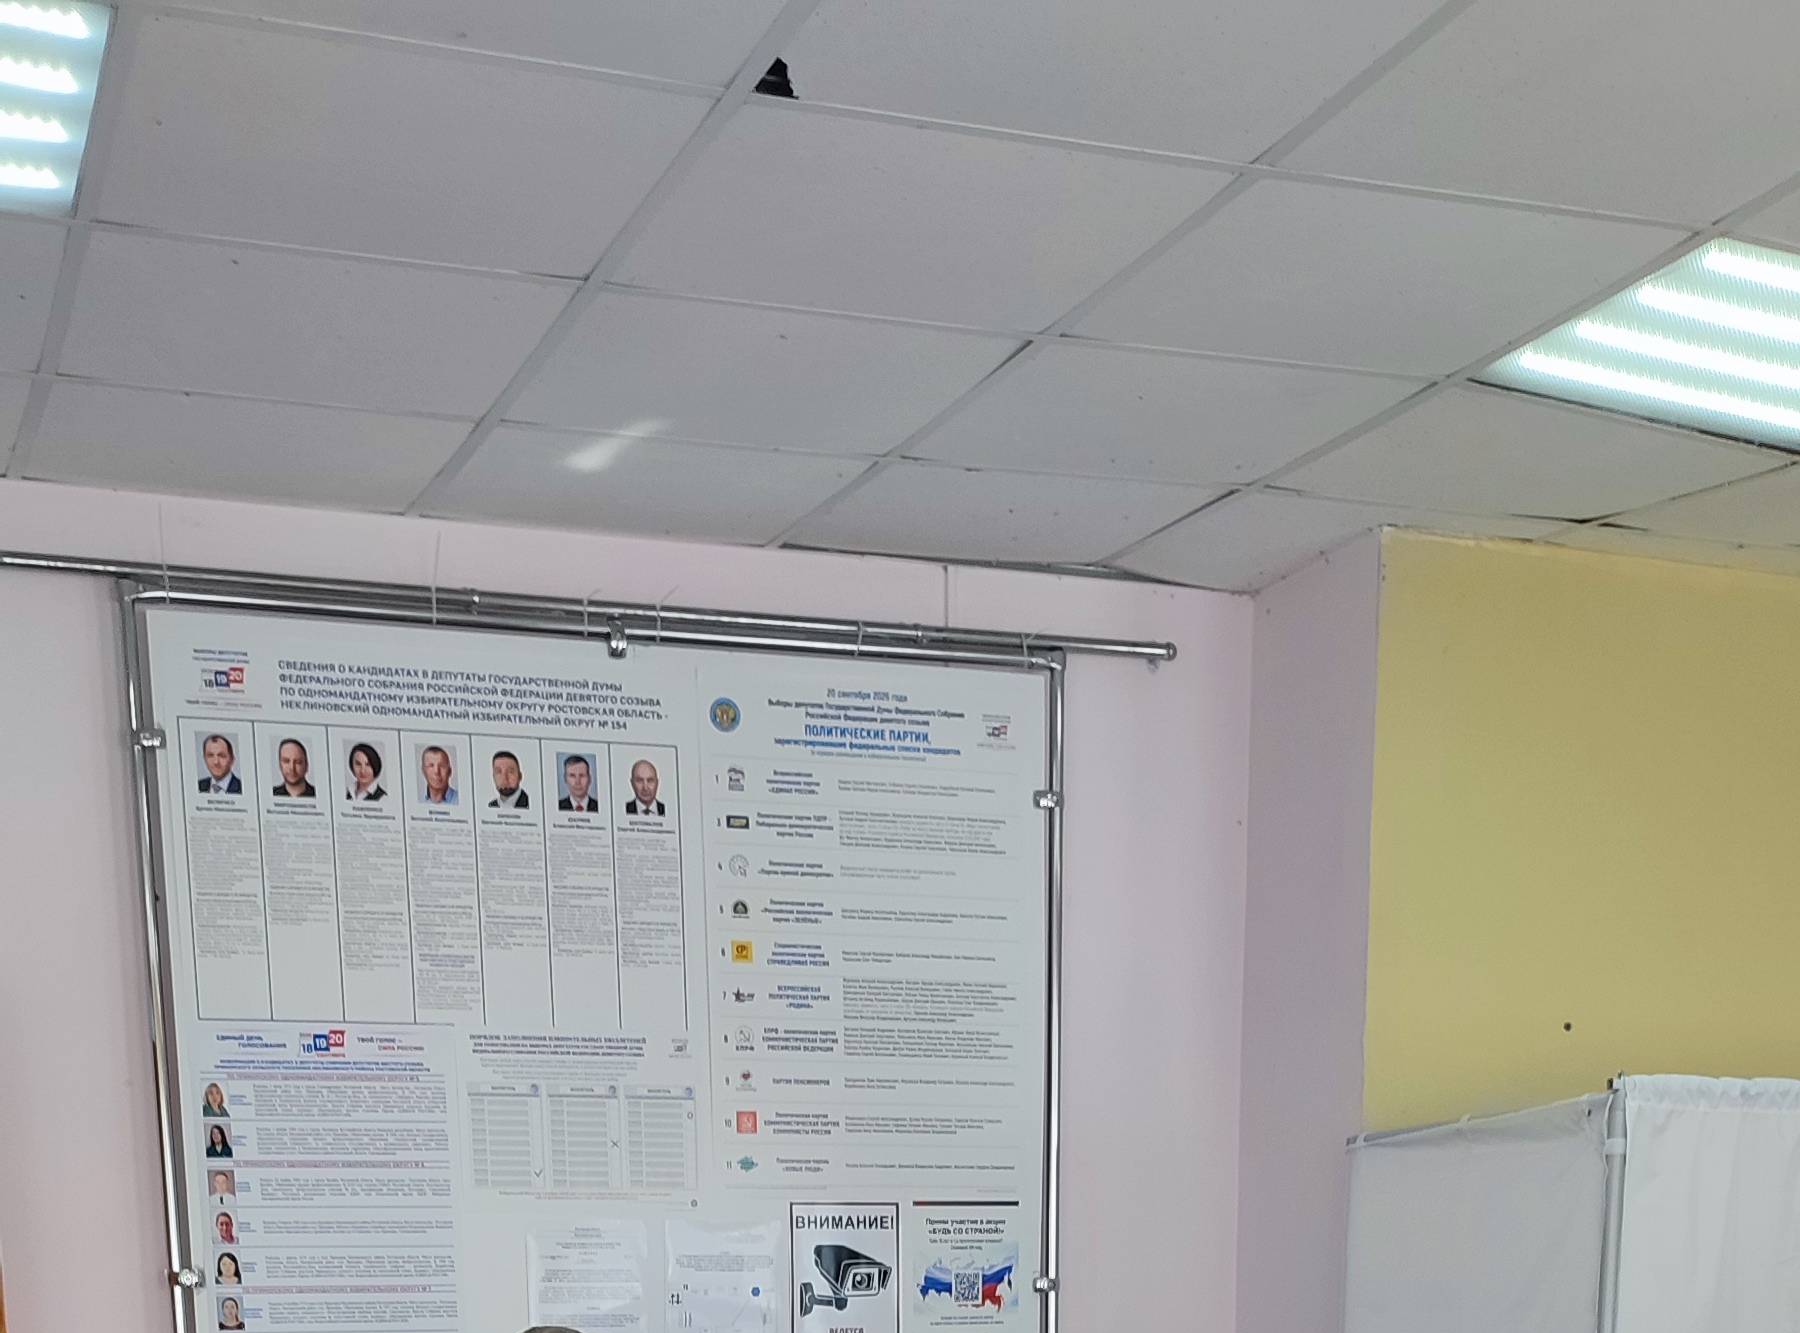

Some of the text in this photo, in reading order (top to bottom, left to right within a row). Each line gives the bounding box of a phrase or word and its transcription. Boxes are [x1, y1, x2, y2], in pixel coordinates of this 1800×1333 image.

[229, 670, 242, 680] 20
[278, 660, 622, 692] СВЕДЕНИЯ О КАНДИДАТАХ В ДЕПУТАТЫ ГОСУДАРСТВЕННОЙ ДУМЫ
[279, 674, 661, 707] ФЕДЕРАЛЬНОГО СОБРАНИЯ РОССИЙСКОЙ ФЕДЕРАЦИИ ДЕВЯТОГО СОЗЫВА
[891, 694, 908, 702] года
[280, 687, 295, 696] ПО
[298, 688, 404, 704] ОДНОМАНДАТНОМУ
[407, 695, 503, 710] ИЗБИРАТЕЛЬНОМУ
[506, 702, 545, 713] ОКРУГУ
[548, 704, 614, 717] РОСТОВСКАЯ
[617, 709, 662, 720] ОБЛАСТЬ
[281, 700, 627, 730] НЕКЛИНОВСКИЙ ОДНОМАНДАТНЫЙ ИЗБИРАТЕЛЬНЫЙ ОКРУГ № 154
[804, 724, 931, 745] ПОЛИТИЧЕСКИЕ ПАРТИИ,
[329, 1033, 343, 1044] 20
[725, 1119, 732, 1128] 10
[726, 1161, 732, 1169] 11
[796, 1215, 894, 1230] ВНИМАНИЕ!
